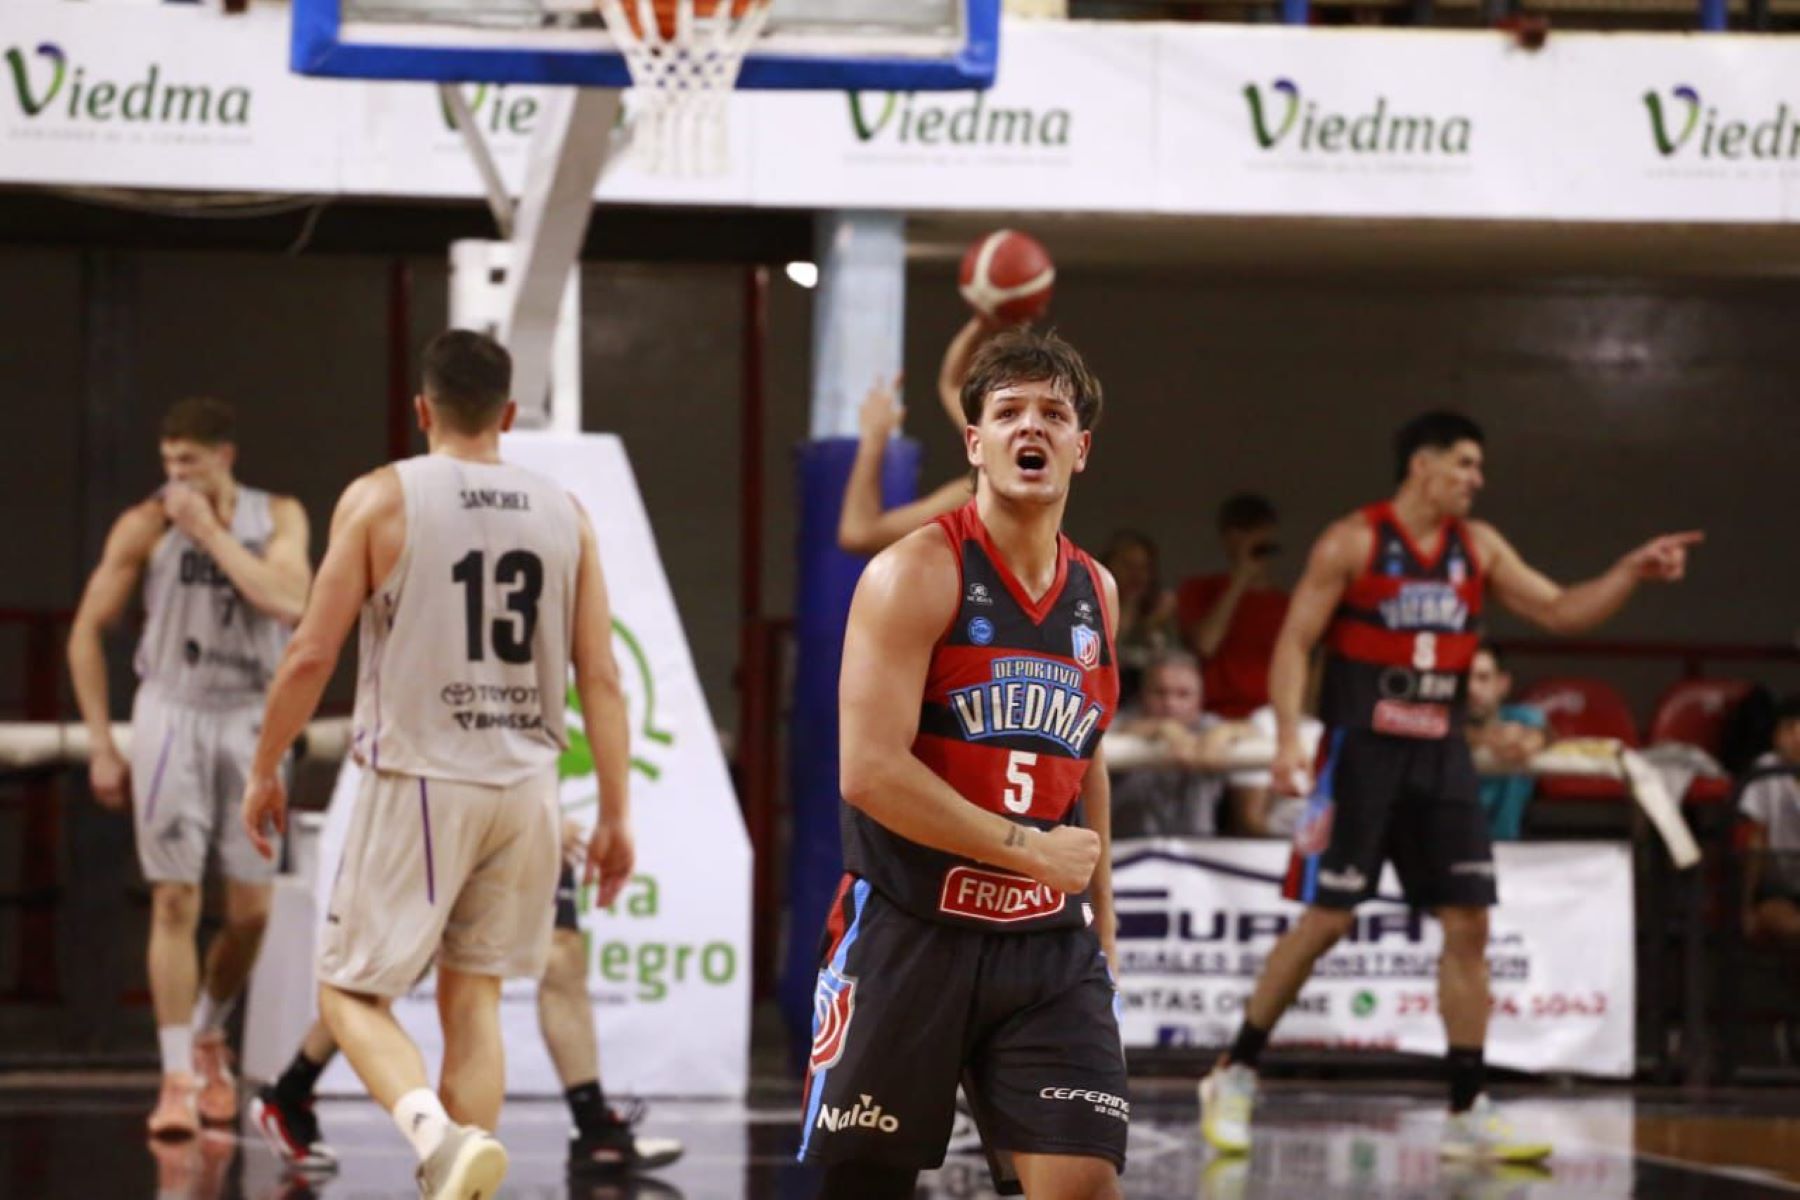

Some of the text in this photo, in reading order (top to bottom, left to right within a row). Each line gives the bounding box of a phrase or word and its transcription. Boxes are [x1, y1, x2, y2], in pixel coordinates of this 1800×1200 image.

[4, 43, 251, 125] Viedma
[846, 89, 1071, 145] Viedma
[1242, 78, 1472, 154] Viedma
[452, 549, 544, 664] 13
[478, 685, 540, 704] TOYOT
[994, 660, 1080, 688] DEPORTIVO
[954, 682, 1101, 751] VIEDMA
[1004, 750, 1038, 813] 5
[816, 1097, 899, 1133] Naldo
